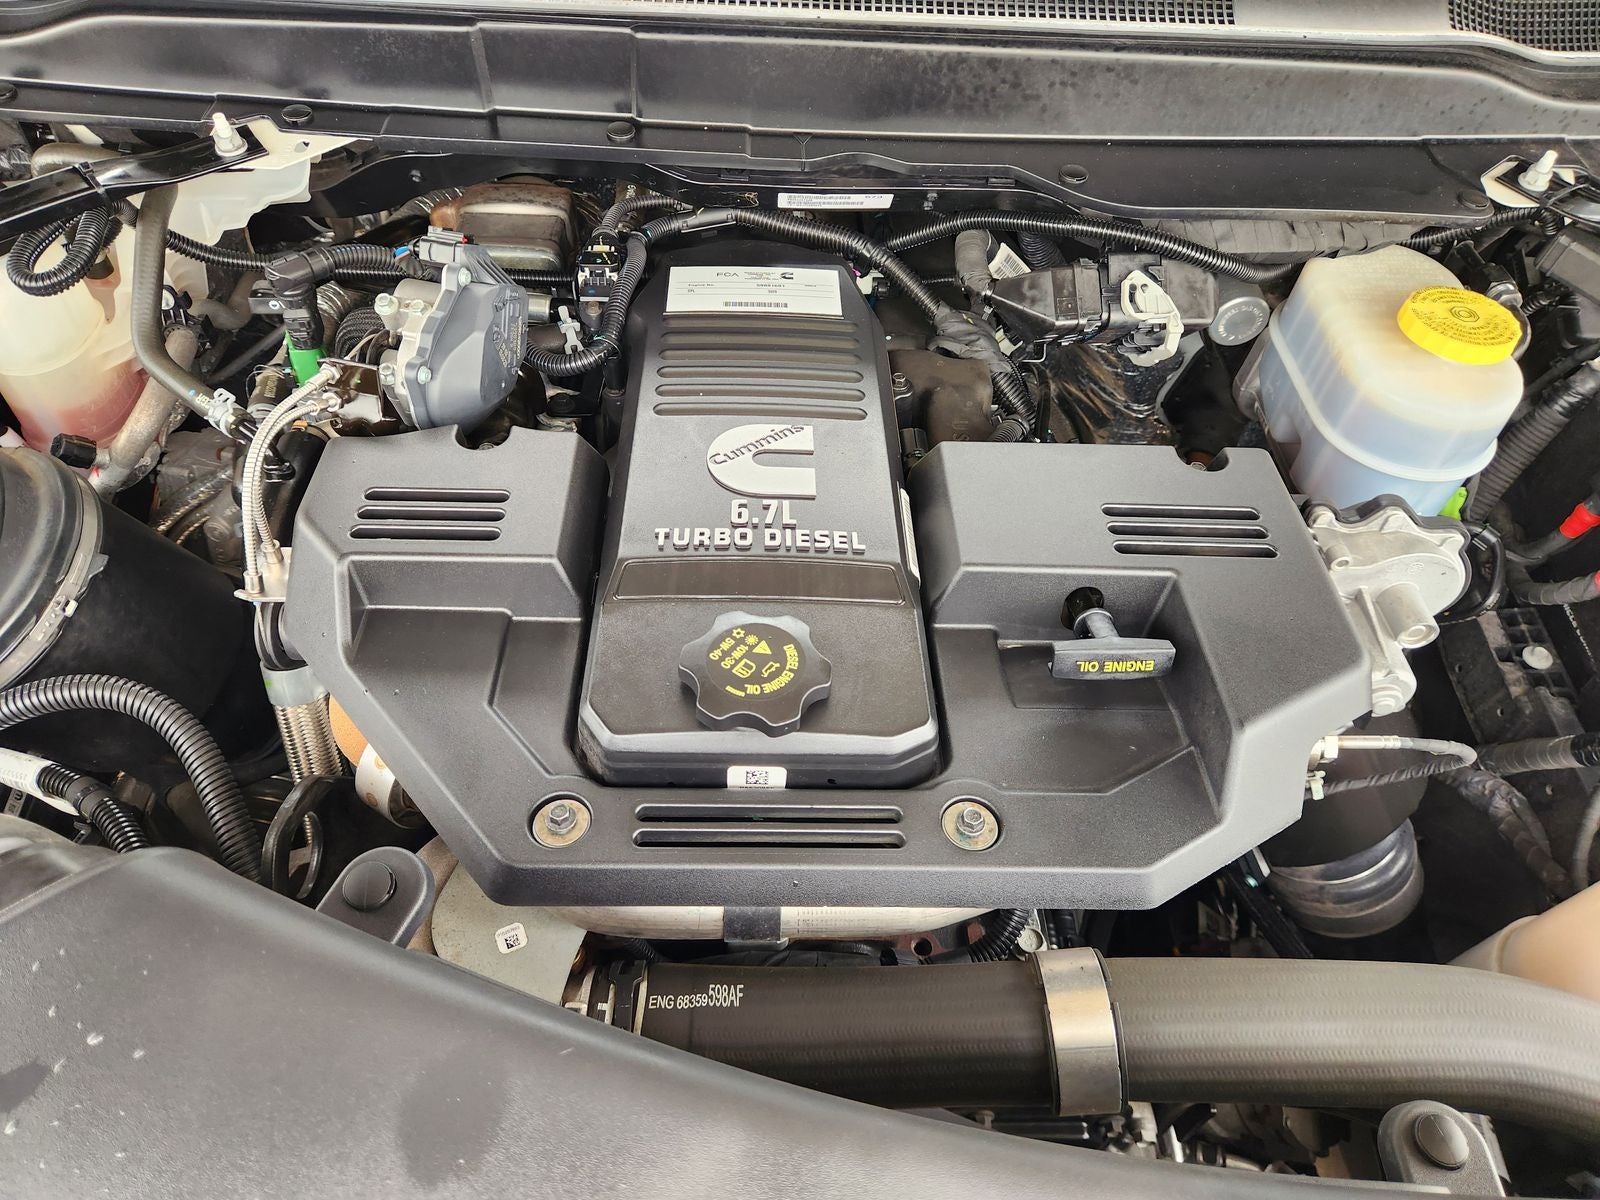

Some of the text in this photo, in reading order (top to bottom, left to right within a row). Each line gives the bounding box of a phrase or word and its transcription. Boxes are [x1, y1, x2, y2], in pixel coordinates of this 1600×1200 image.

[708, 425, 805, 465] Cummins
[731, 499, 797, 527] 6.7L
[654, 527, 867, 554] TURBO DIESEL
[708, 637, 736, 661] 5W-40
[720, 644, 749, 669] 10W-30
[744, 643, 799, 695] DIESEL ENGINE OIL
[1076, 660, 1155, 673] ENGINE OIL
[648, 984, 745, 1010] ENG 68359598AF
